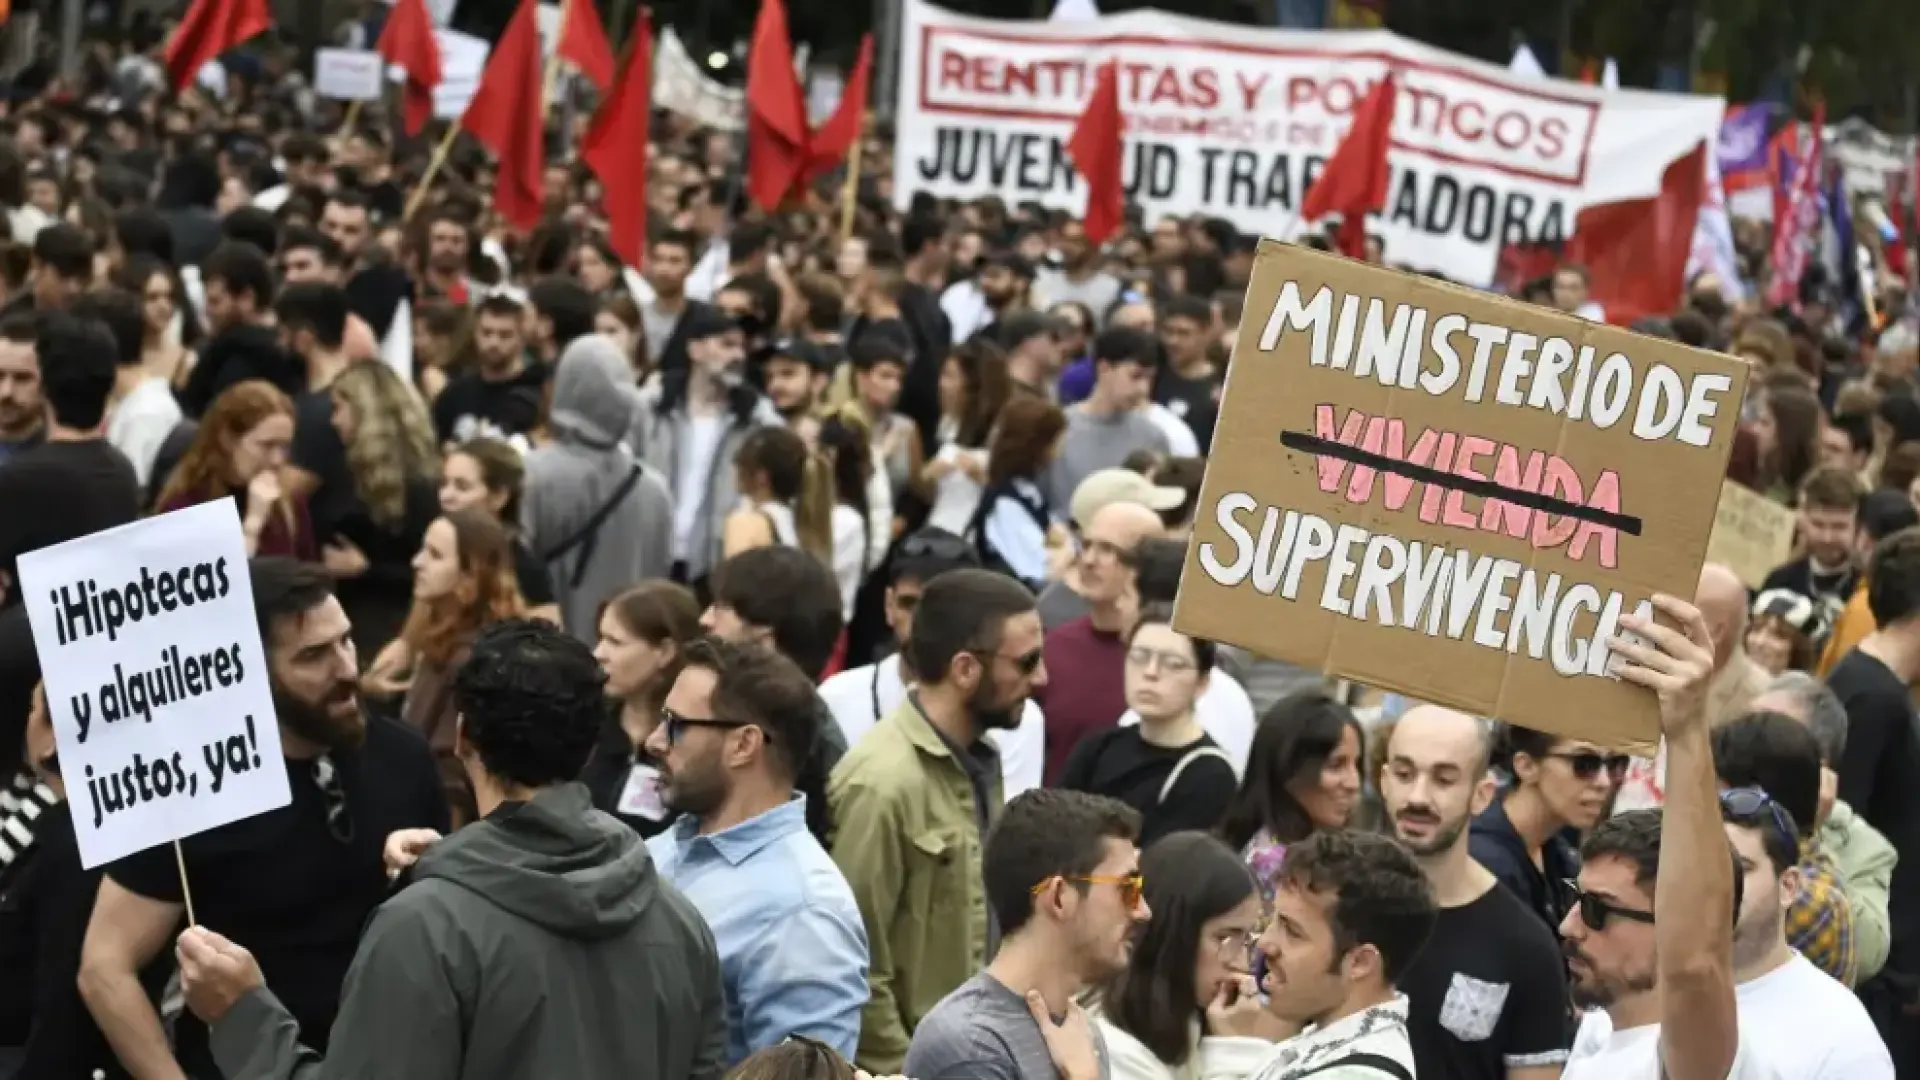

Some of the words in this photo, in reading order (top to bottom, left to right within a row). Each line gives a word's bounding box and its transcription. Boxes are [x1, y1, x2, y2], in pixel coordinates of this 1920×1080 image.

[940, 50, 1219, 108] RENTITAS
[1237, 71, 1268, 111] Y
[1288, 76, 1570, 159] POTICOS
[917, 127, 1177, 199] JUVENUD
[1258, 279, 1633, 430] MINISTERIO
[1632, 363, 1732, 447] DE
[1313, 403, 1623, 569] VIVIENDA
[50, 556, 230, 645] ¡Hipotecas
[71, 692, 91, 744] y
[100, 643, 244, 723] alquileres
[85, 751, 198, 829] justos,
[203, 714, 261, 794] ya!
